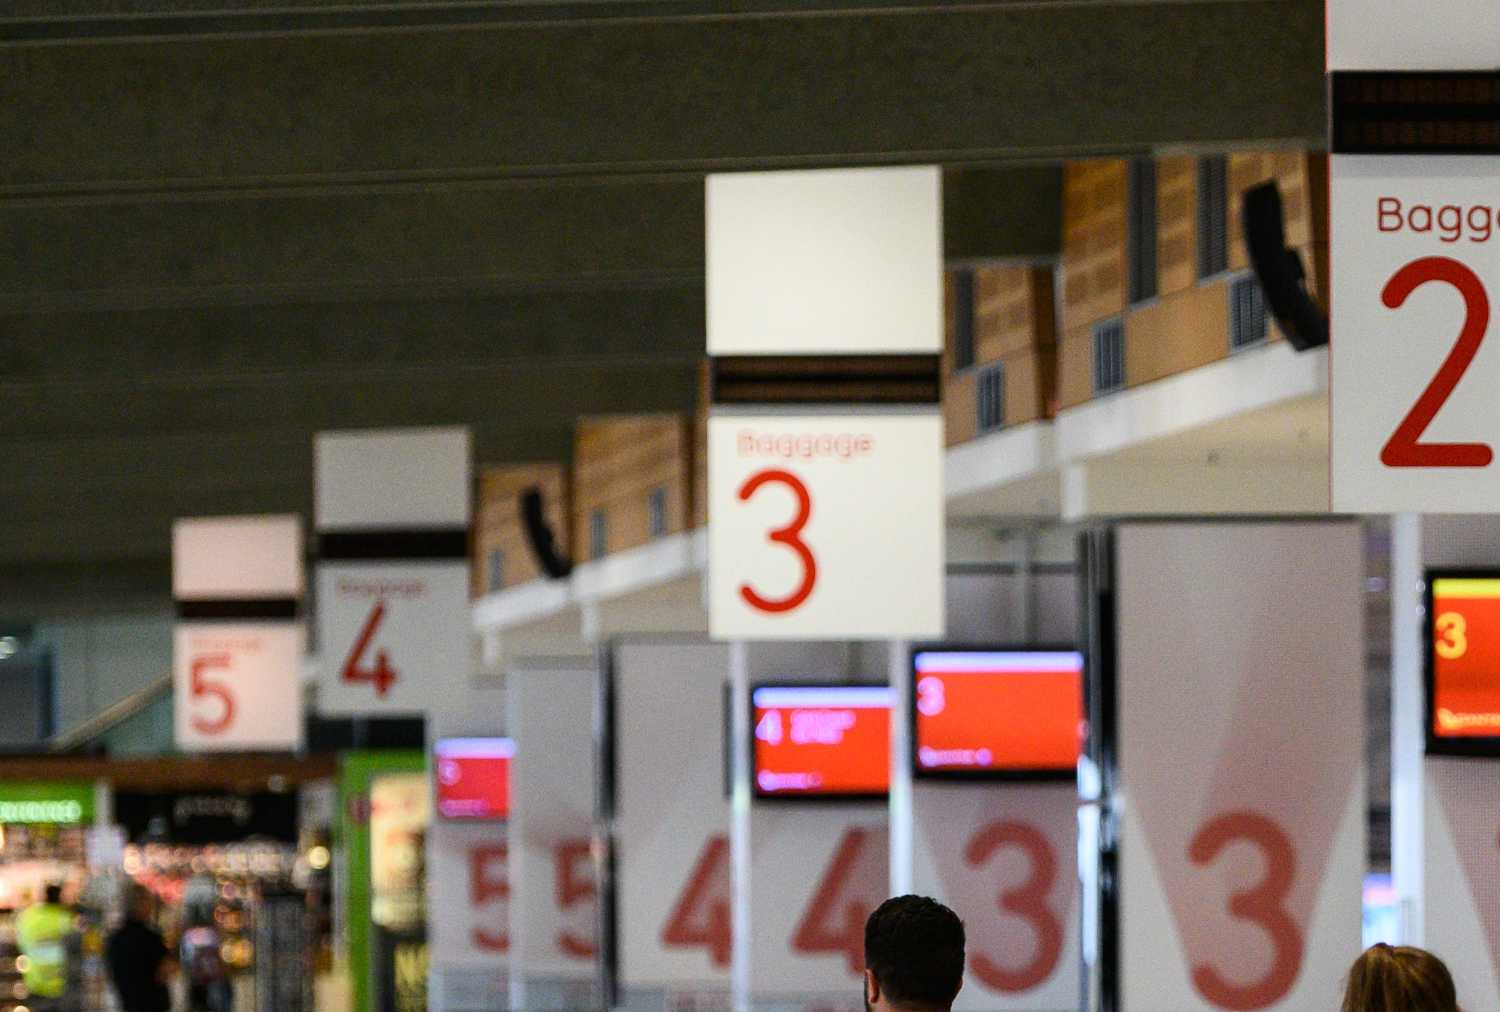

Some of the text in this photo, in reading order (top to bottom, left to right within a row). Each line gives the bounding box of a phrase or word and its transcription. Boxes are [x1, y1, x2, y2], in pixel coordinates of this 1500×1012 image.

[1379, 255, 1494, 468] 2
[738, 433, 873, 460] Baggage
[736, 467, 820, 614] 3
[340, 602, 398, 698] 4
[1435, 611, 1468, 660] 3
[190, 653, 237, 734] 5
[755, 708, 784, 746] 4
[916, 675, 945, 716] 3
[661, 834, 733, 968] 4
[790, 827, 868, 977] 4
[966, 820, 1064, 992] 3
[1188, 811, 1305, 1012] 3
